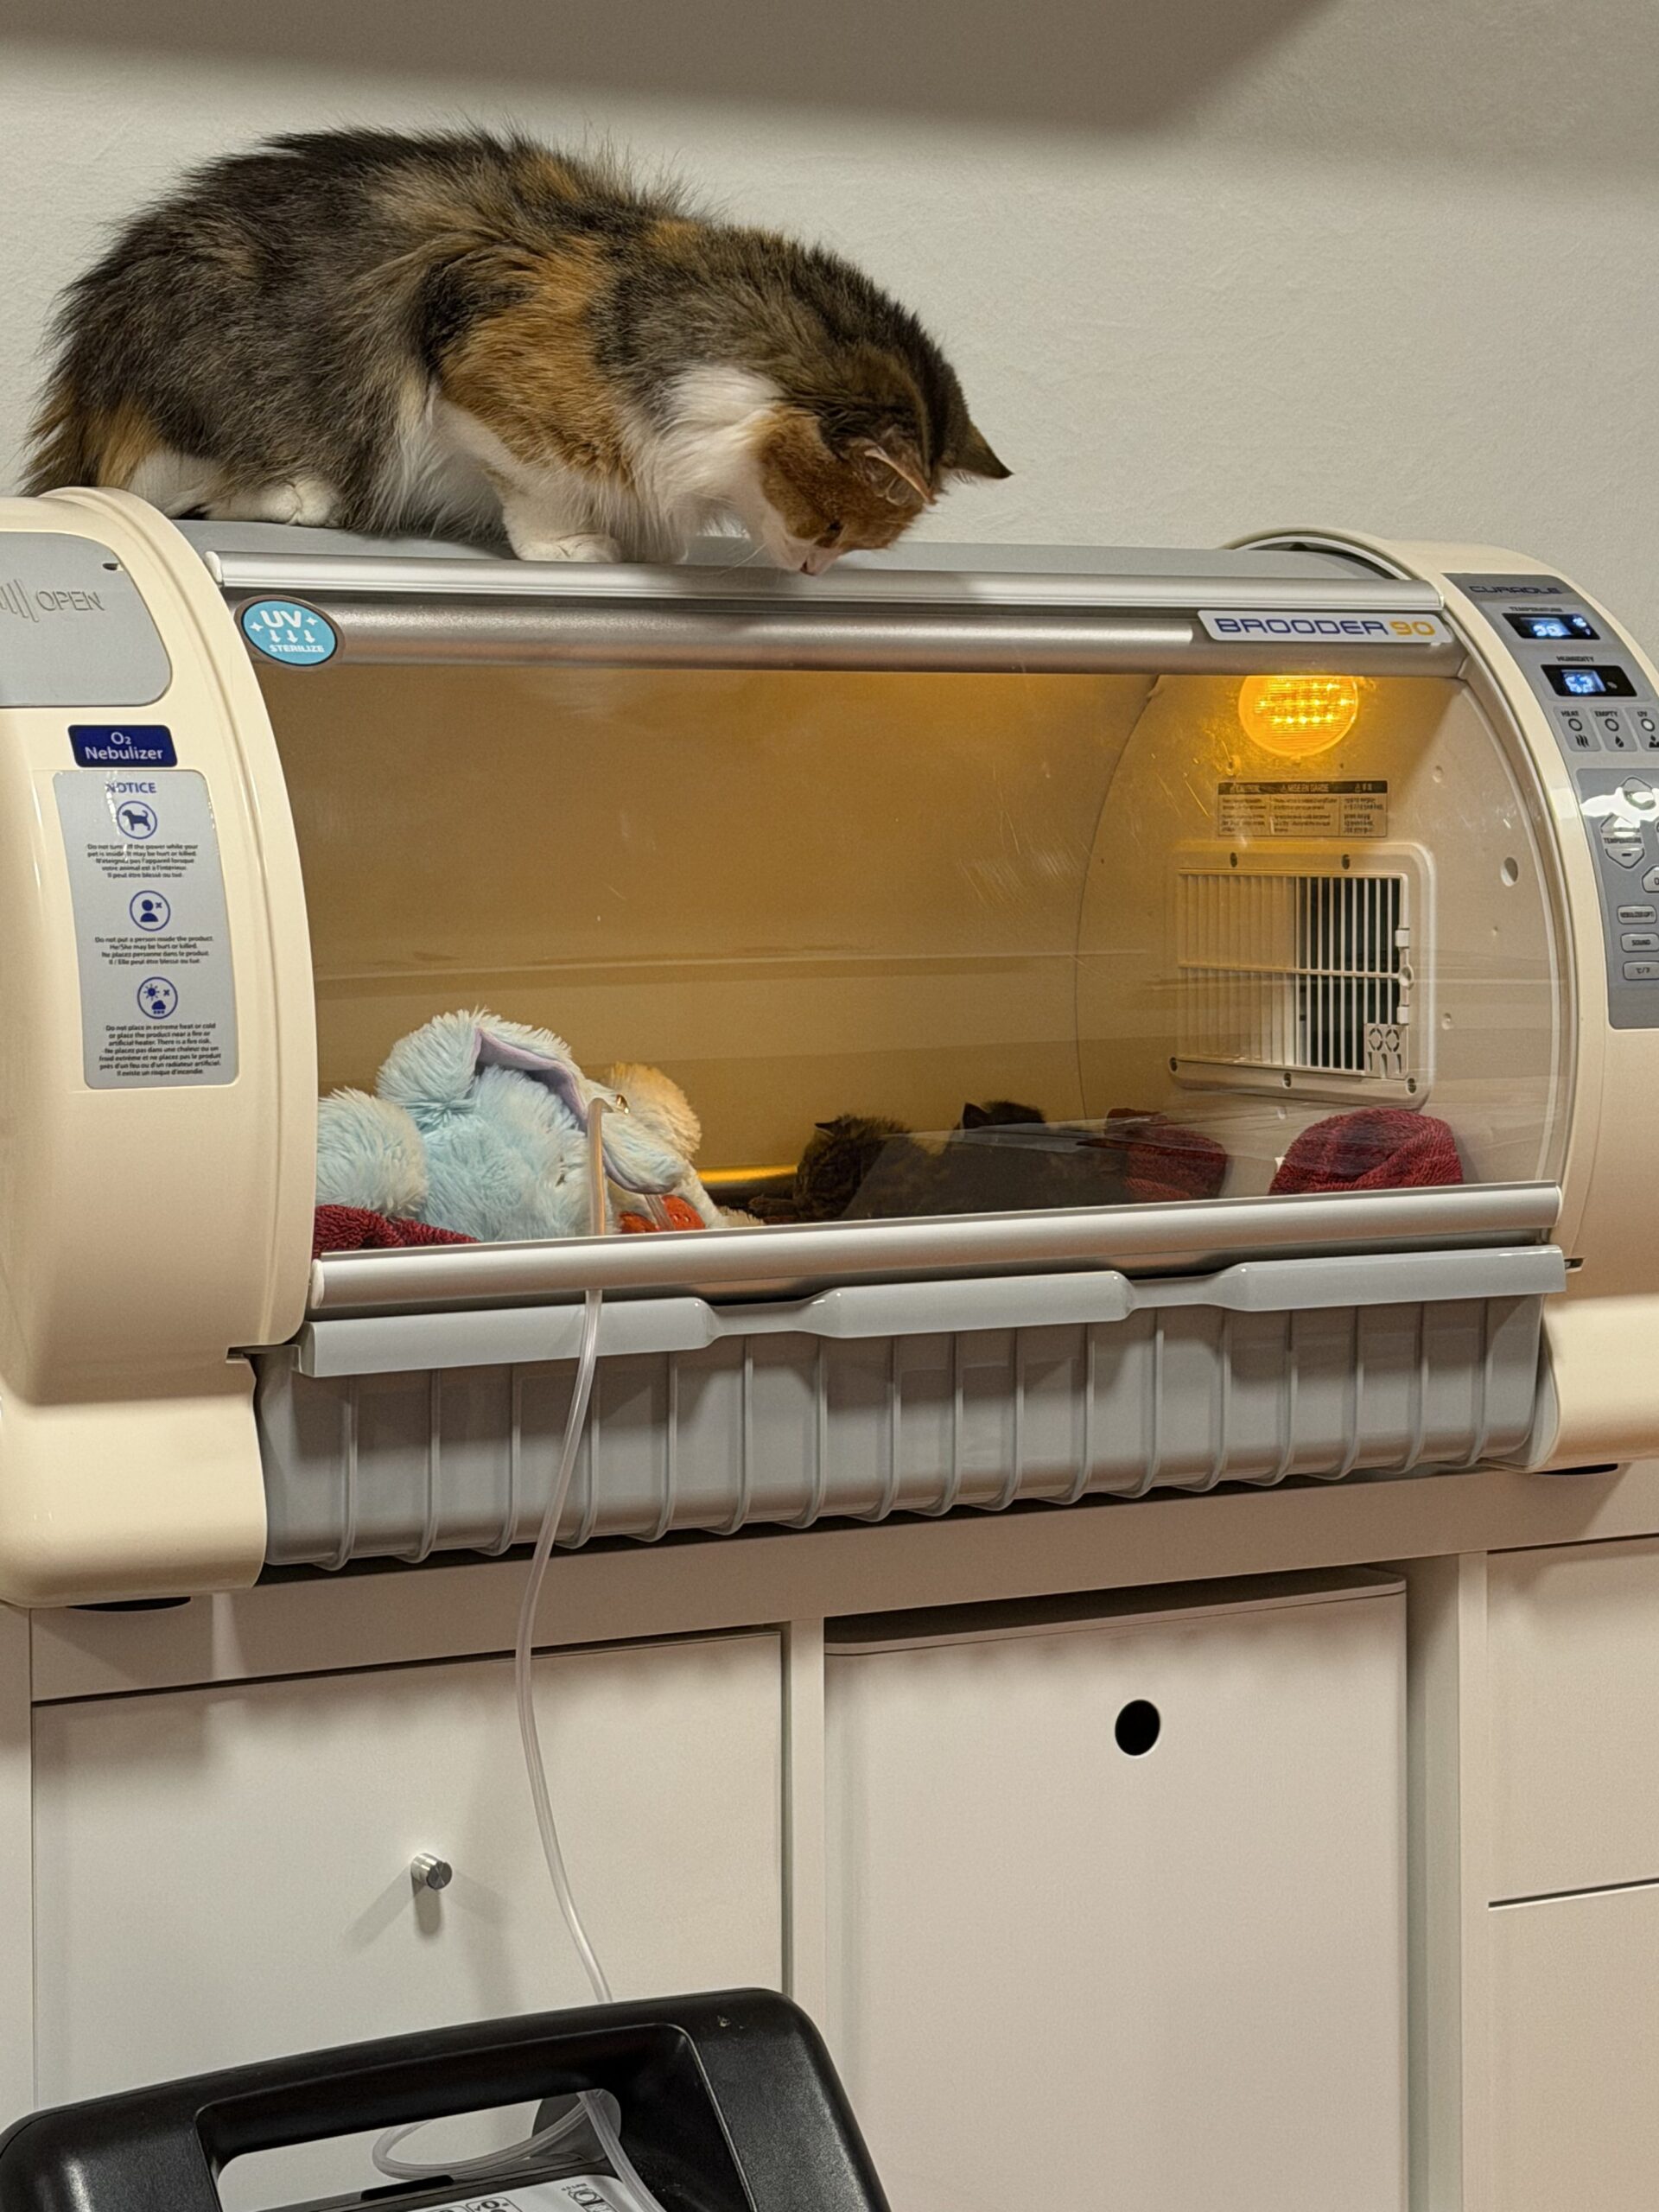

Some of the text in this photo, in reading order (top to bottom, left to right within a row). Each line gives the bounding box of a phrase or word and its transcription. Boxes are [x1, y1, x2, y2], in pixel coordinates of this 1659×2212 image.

[36, 590, 105, 611] OPEN
[260, 610, 302, 628] UV
[269, 644, 325, 653] STERILIZE
[85, 746, 163, 760] Nebulizer
[105, 782, 157, 793] NOTICE
